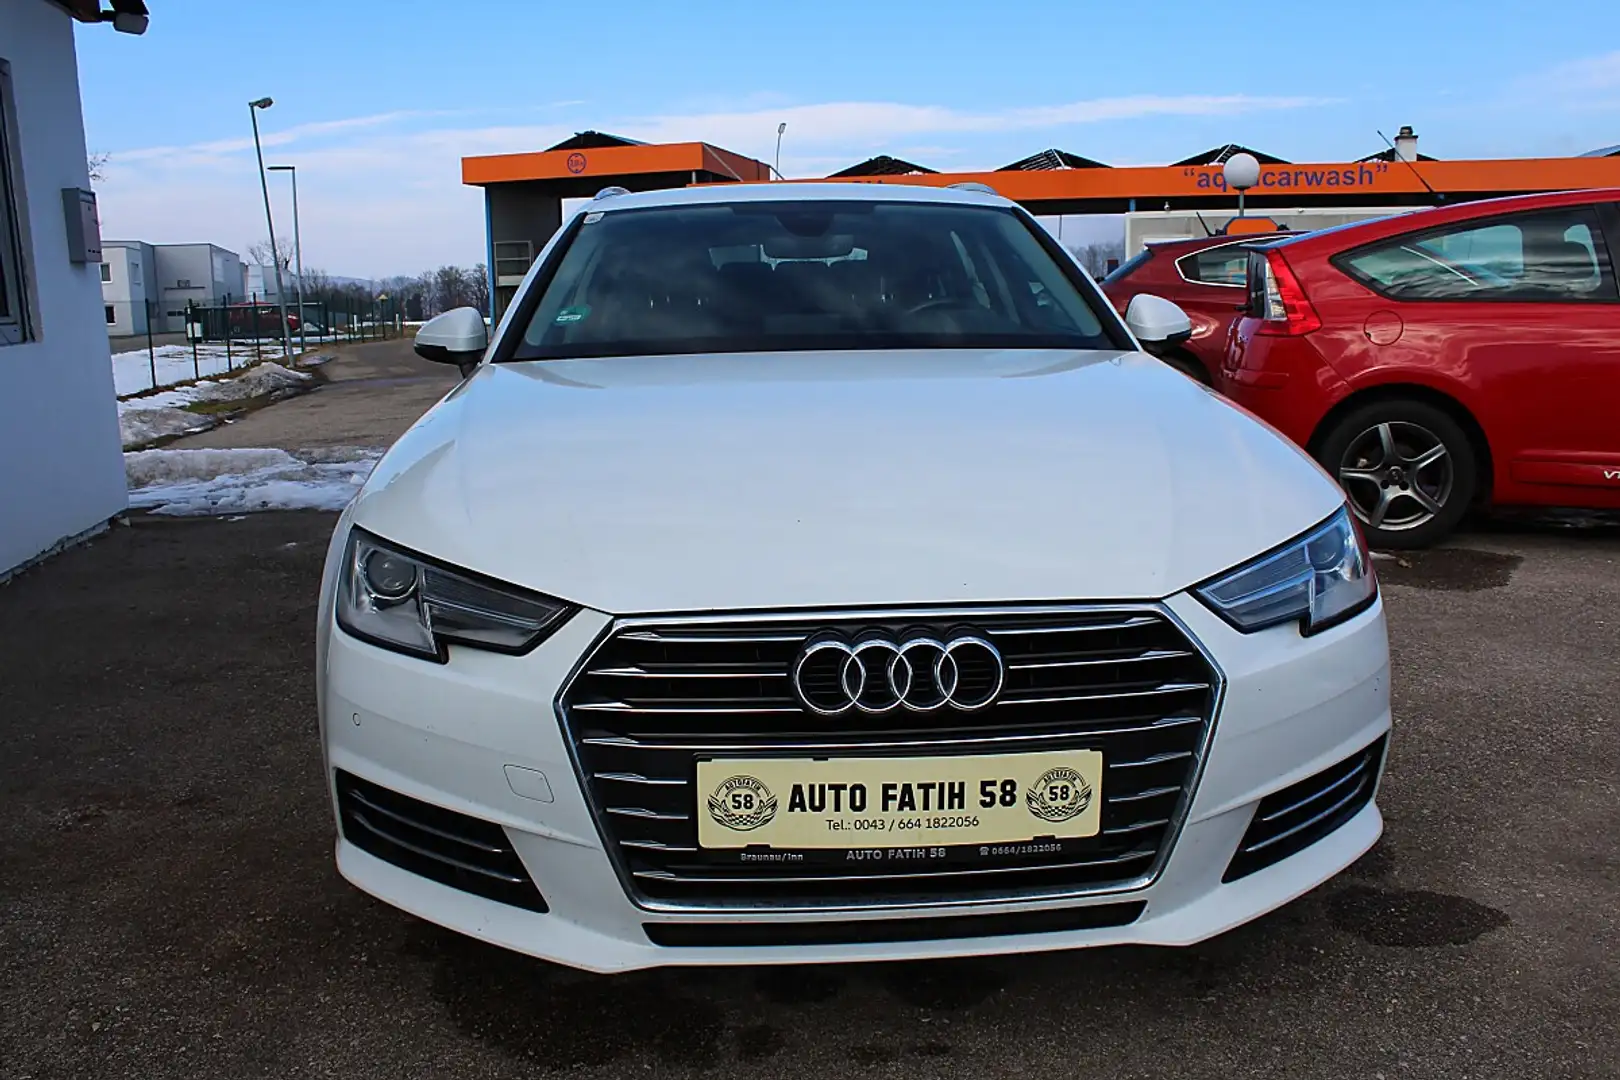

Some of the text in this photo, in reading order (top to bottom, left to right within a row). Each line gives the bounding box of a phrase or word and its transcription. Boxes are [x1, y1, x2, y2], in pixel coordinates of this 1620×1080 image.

[731, 793, 755, 810] 58
[787, 779, 1017, 813] AUTO FATIH 58
[1048, 784, 1070, 802] 58
[825, 819, 851, 831] Tel.:
[854, 819, 886, 831] 0043
[897, 817, 922, 830] 664
[925, 815, 980, 829] 1822056
[846, 847, 947, 860] AUTO FATIH 58
